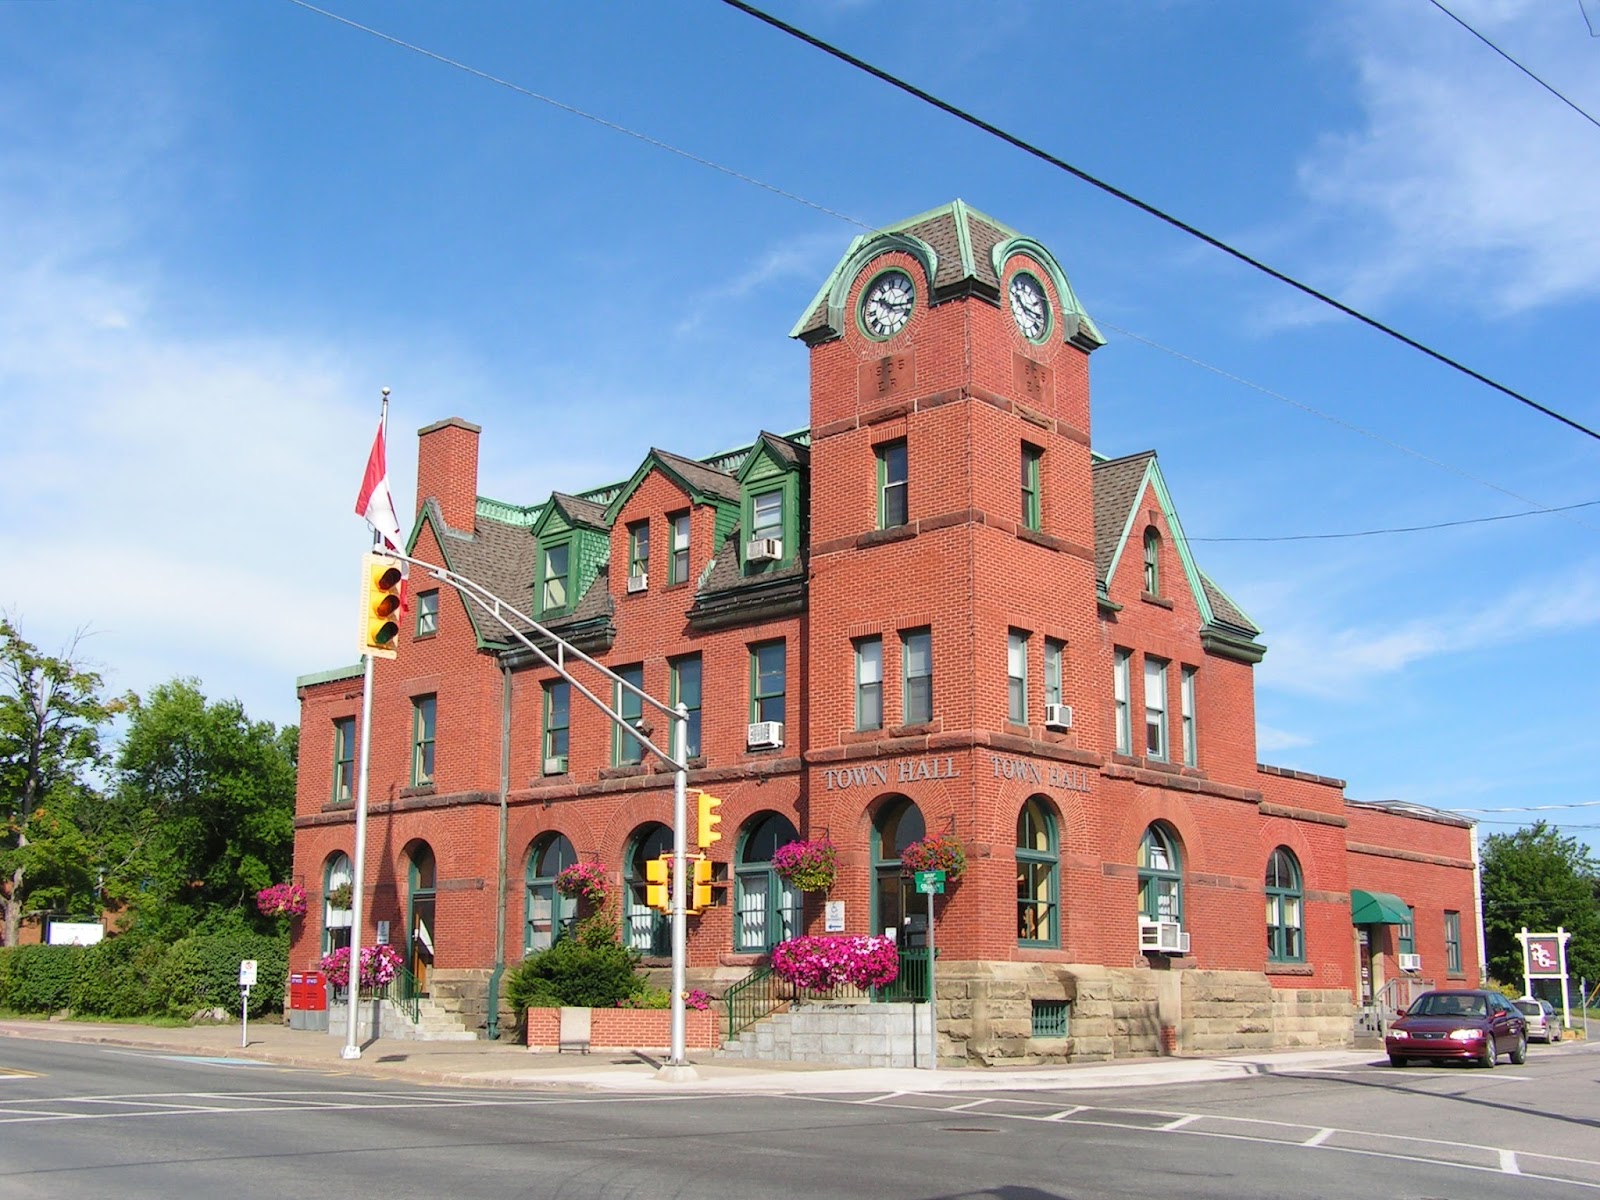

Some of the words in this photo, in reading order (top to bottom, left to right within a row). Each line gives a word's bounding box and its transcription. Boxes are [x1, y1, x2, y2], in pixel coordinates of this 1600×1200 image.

[824, 766, 889, 790] TOWN
[898, 757, 961, 783] HALL
[990, 756, 1042, 784] TOWN
[1048, 766, 1091, 792] HALL
